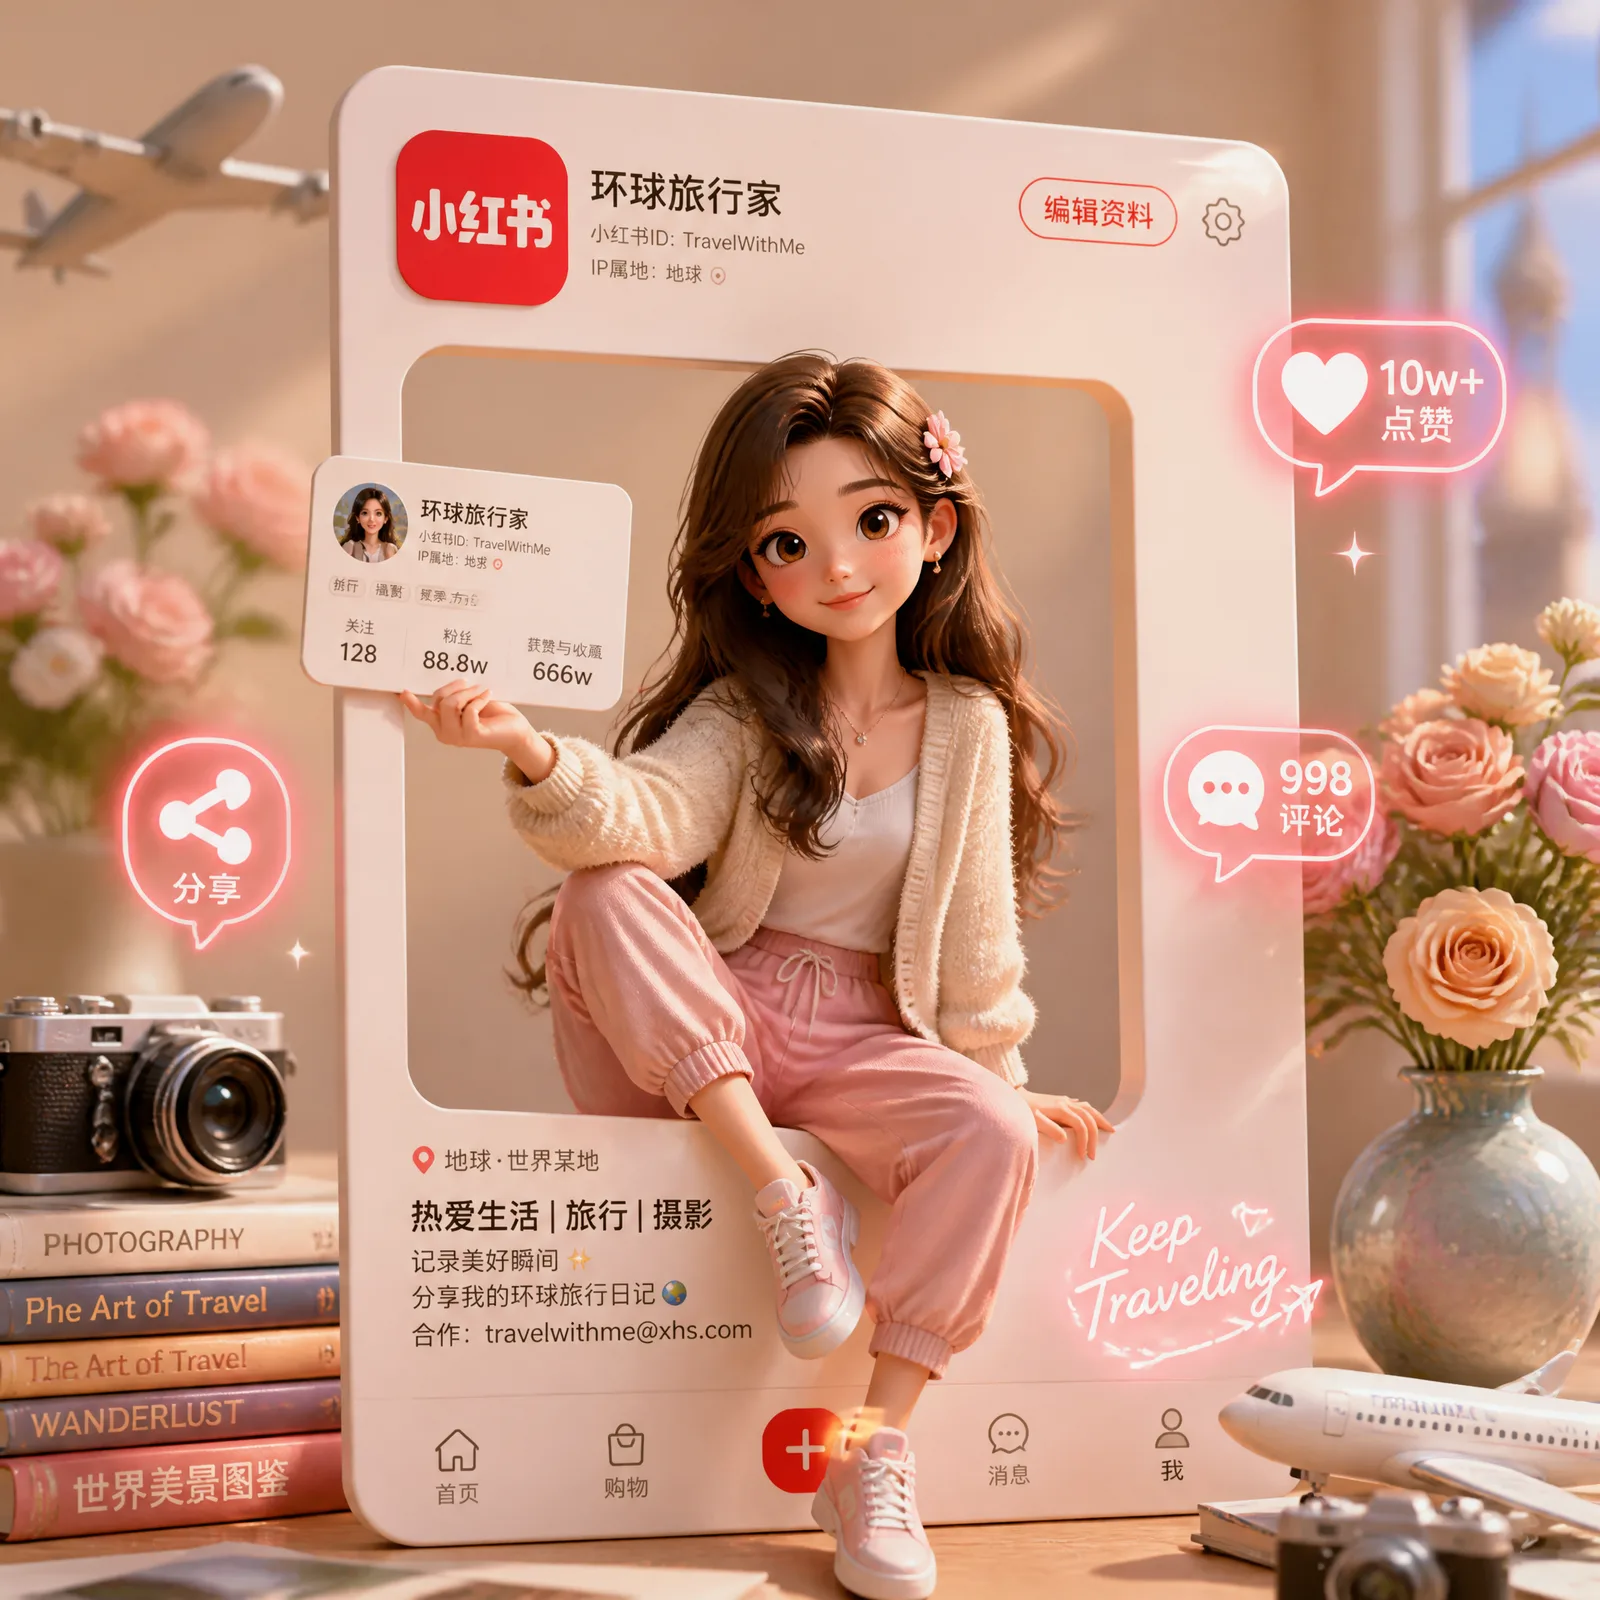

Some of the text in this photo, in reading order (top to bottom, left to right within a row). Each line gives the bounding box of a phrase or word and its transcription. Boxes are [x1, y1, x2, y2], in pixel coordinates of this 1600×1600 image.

[590, 169, 782, 217] 环球旅行家
[411, 188, 553, 249] 小红书
[1044, 195, 1154, 230] 编辑资料
[683, 232, 806, 257] TravelWithMe
[1379, 359, 1485, 397] 10w+
[1380, 405, 1454, 443] 点赞
[420, 499, 529, 531] 环球旅行家
[473, 536, 551, 556] TravelWithMe
[345, 618, 375, 635] 关注
[340, 642, 378, 664] 128
[422, 650, 489, 675] 88.8w
[532, 661, 593, 686] 666w
[1280, 759, 1353, 797] 998
[1279, 803, 1345, 837] 评论
[172, 872, 241, 905] 分享
[43, 1227, 245, 1257] PHOTOGRAPHY
[1090, 1202, 1202, 1269] Keep
[411, 1249, 559, 1274] 记录美好瞬间
[25, 1286, 268, 1325] Phe Art of Travel
[411, 1282, 656, 1310] 分享我的环球旅行日记
[1074, 1247, 1287, 1341] Traveling
[485, 1320, 753, 1345] travelwithme@xhs.com
[25, 1343, 247, 1382] The Art of Travel
[31, 1398, 245, 1438] WANDERLUST
[72, 1458, 290, 1514] 世界美景图鉴
[988, 1463, 1031, 1486] 消息
[1160, 1459, 1184, 1482] 我
[435, 1482, 479, 1505] 首页
[604, 1476, 649, 1499] 购物
